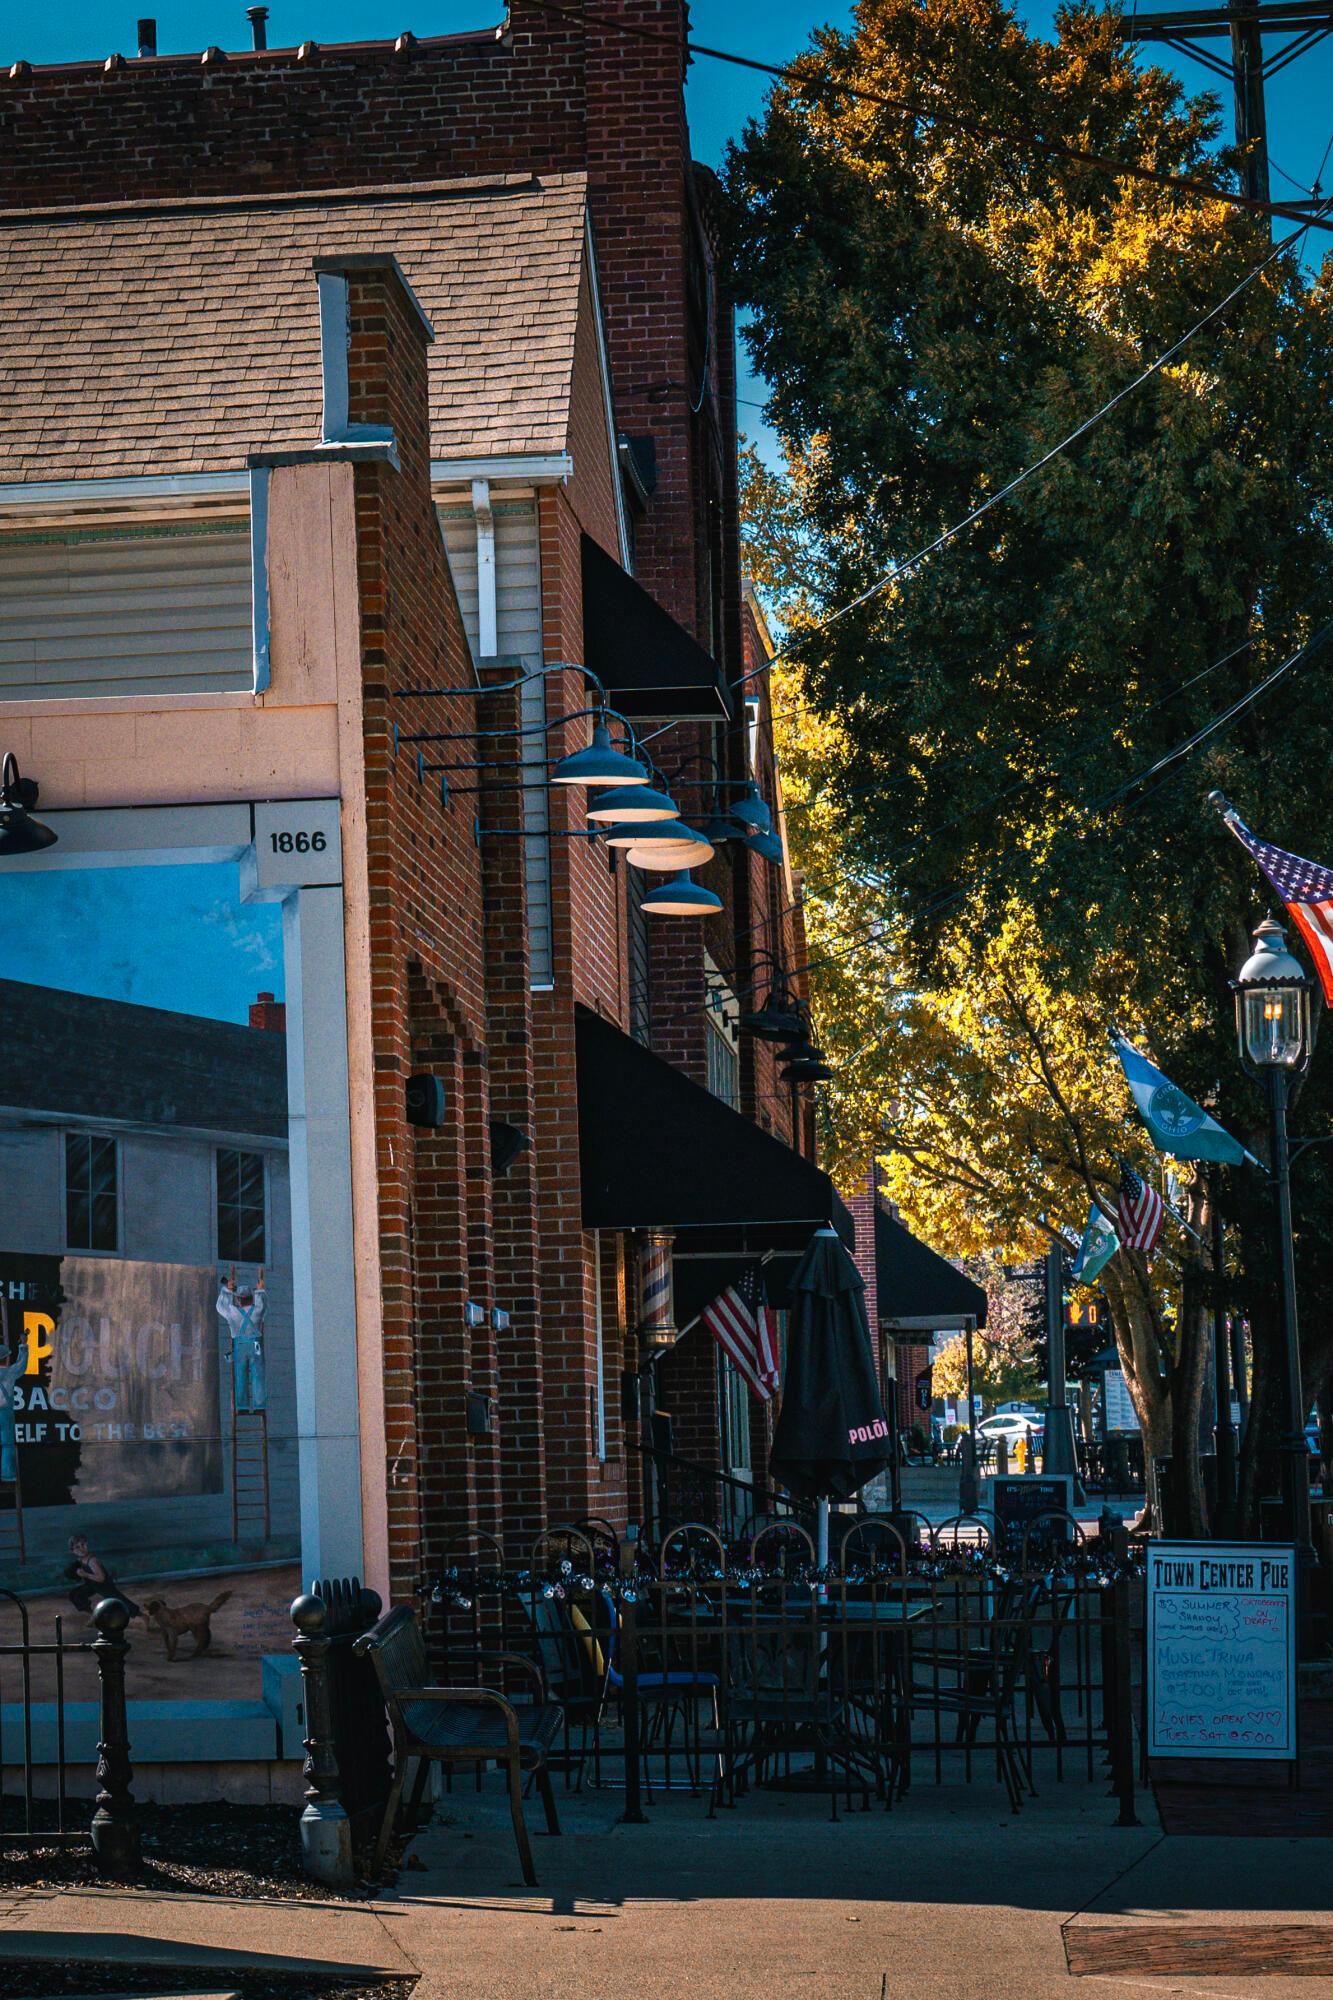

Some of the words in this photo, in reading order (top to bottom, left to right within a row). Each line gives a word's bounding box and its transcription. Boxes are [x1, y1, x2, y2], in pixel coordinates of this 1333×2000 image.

[270, 831, 327, 854] 1866
[1161, 1122, 1188, 1134] OHIO
[12, 1386, 117, 1411] BACCO
[14, 1422, 48, 1443] ELF
[54, 1422, 82, 1442] TO
[93, 1422, 137, 1441] THE
[1153, 1559, 1195, 1589] TOWN
[1199, 1560, 1254, 1591] CENTER
[1260, 1562, 1289, 1591] PUB
[1181, 1599, 1234, 1613] SUMMER
[1178, 1612, 1221, 1625] SHANDY
[1157, 1647, 1205, 1665] MUSIC
[1205, 1648, 1254, 1664] TRIVIA
[1223, 1668, 1284, 1682] MONDAYS
[1212, 1714, 1245, 1725] OPEN
